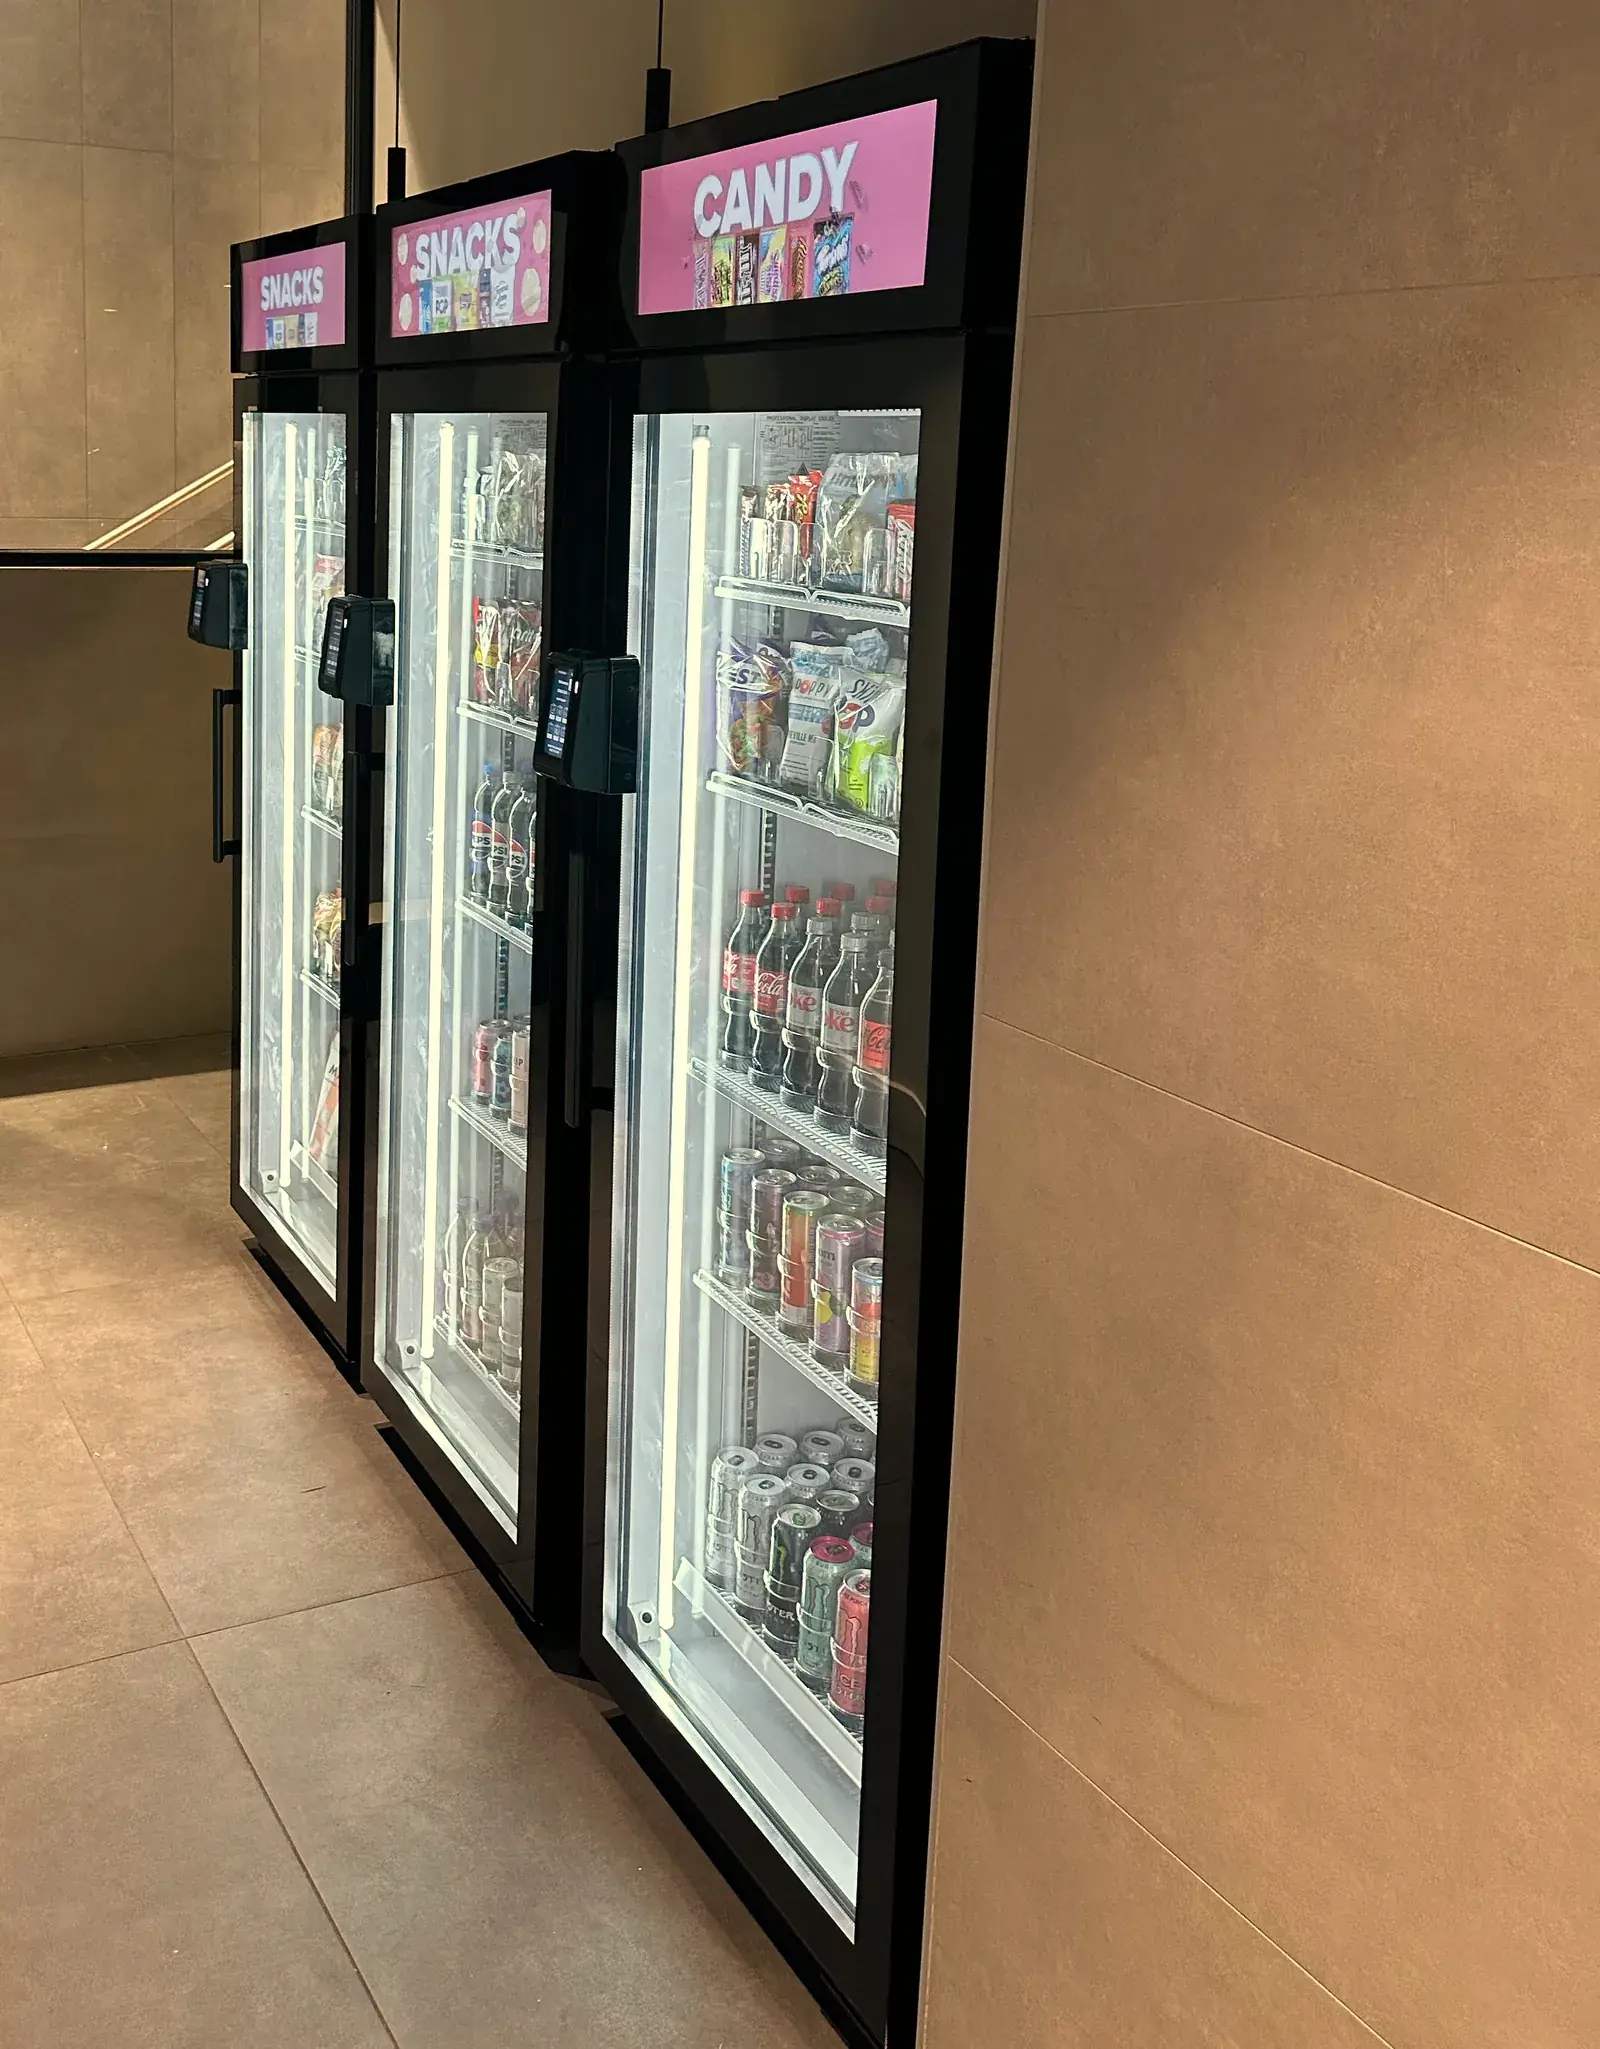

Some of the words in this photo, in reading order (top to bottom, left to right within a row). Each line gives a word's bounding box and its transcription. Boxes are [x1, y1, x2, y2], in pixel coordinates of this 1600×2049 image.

[693, 140, 859, 238] CANDY
[415, 213, 521, 281] SNACKS
[260, 266, 324, 312] SNACKS
[788, 730, 807, 742] EVILLE
[493, 845, 508, 856] PSI
[511, 854, 525, 865] PSI
[792, 987, 818, 1013] ke
[824, 1007, 856, 1034] ke
[767, 1602, 796, 1622] STER
